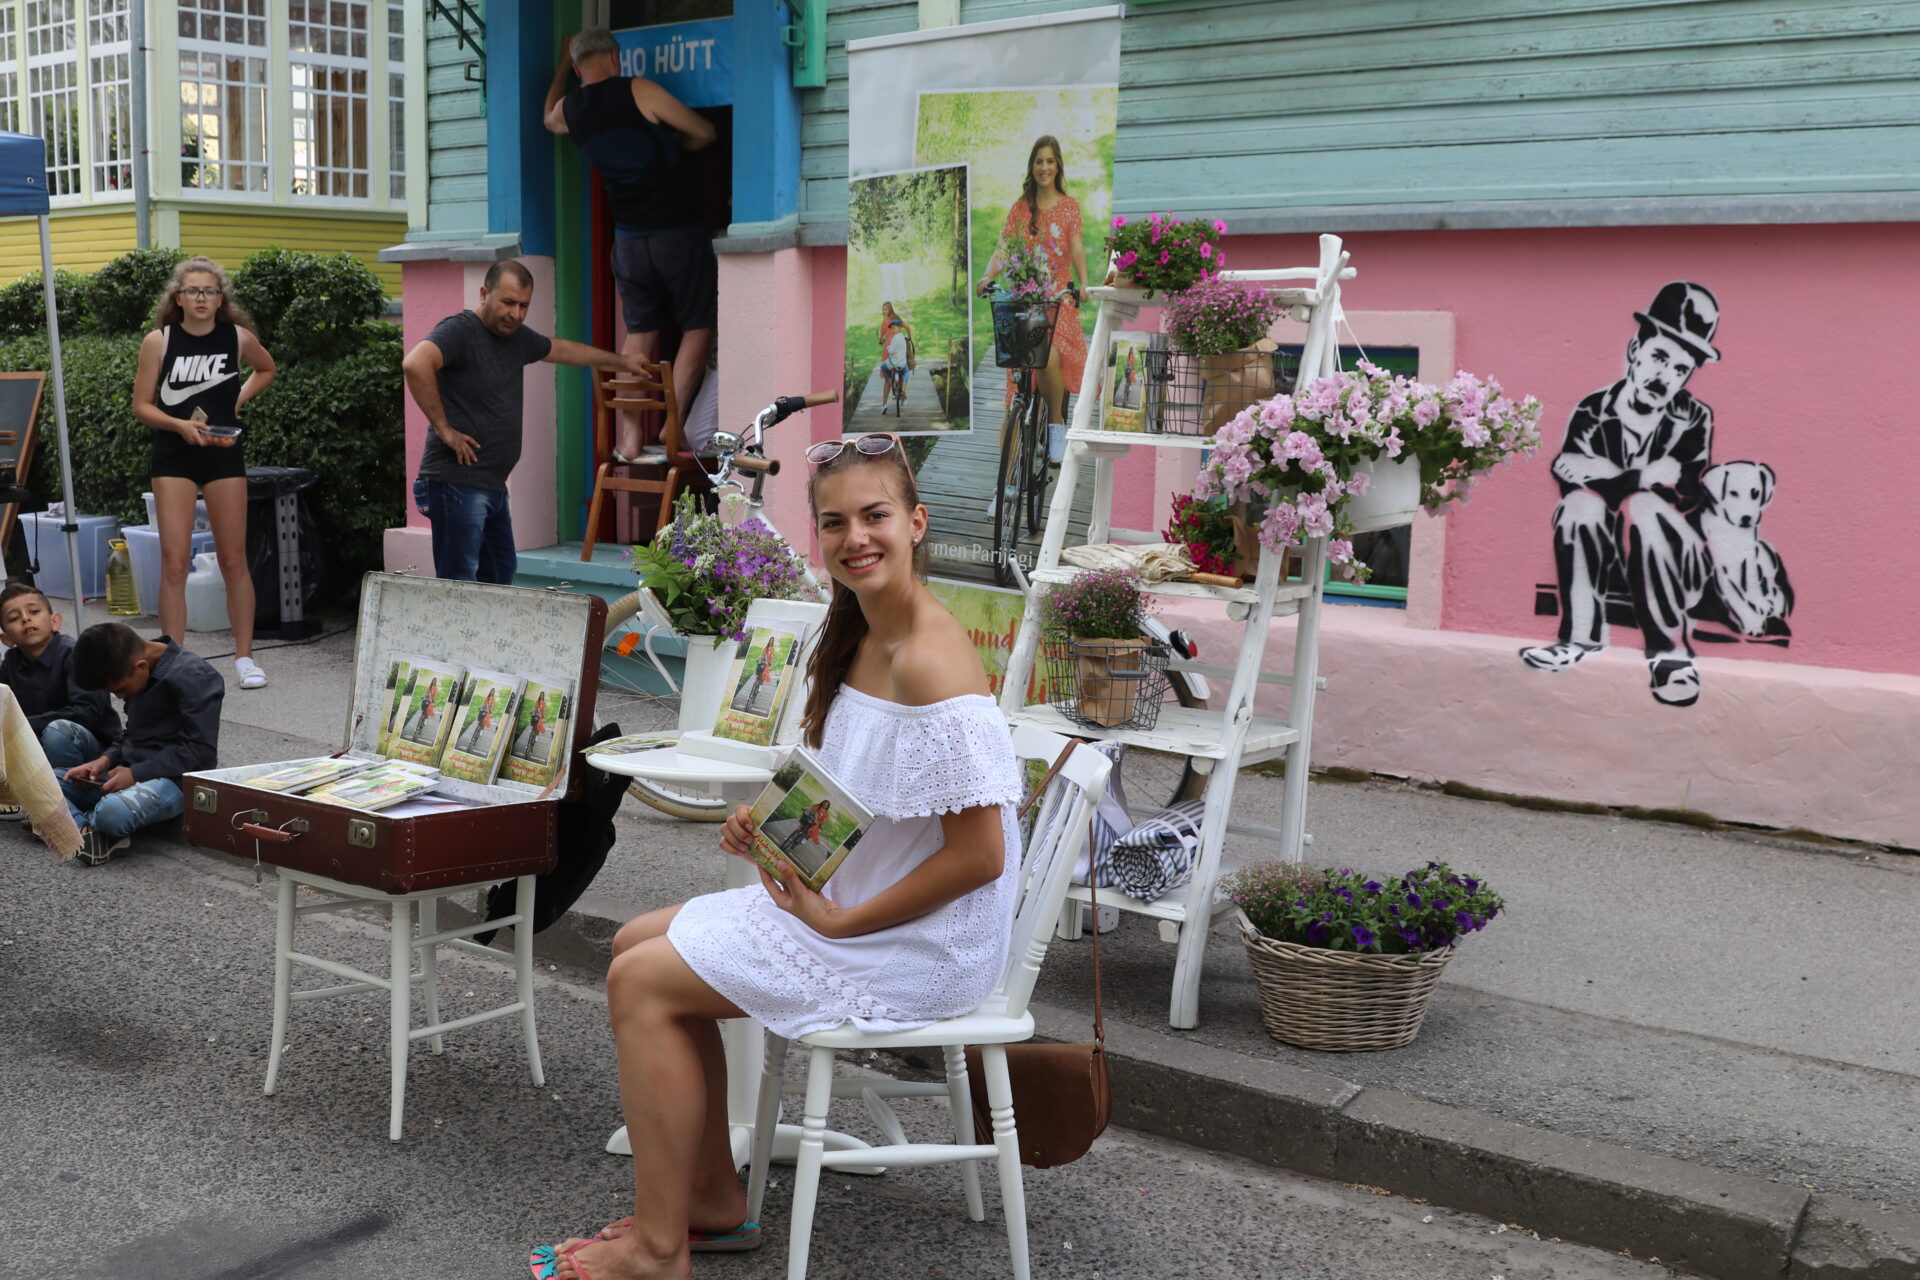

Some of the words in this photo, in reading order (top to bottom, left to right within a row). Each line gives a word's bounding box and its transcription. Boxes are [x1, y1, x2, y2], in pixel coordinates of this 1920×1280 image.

[654, 34, 715, 74] HÜTT
[169, 353, 229, 383] NIKE
[928, 541, 967, 559] rmen
